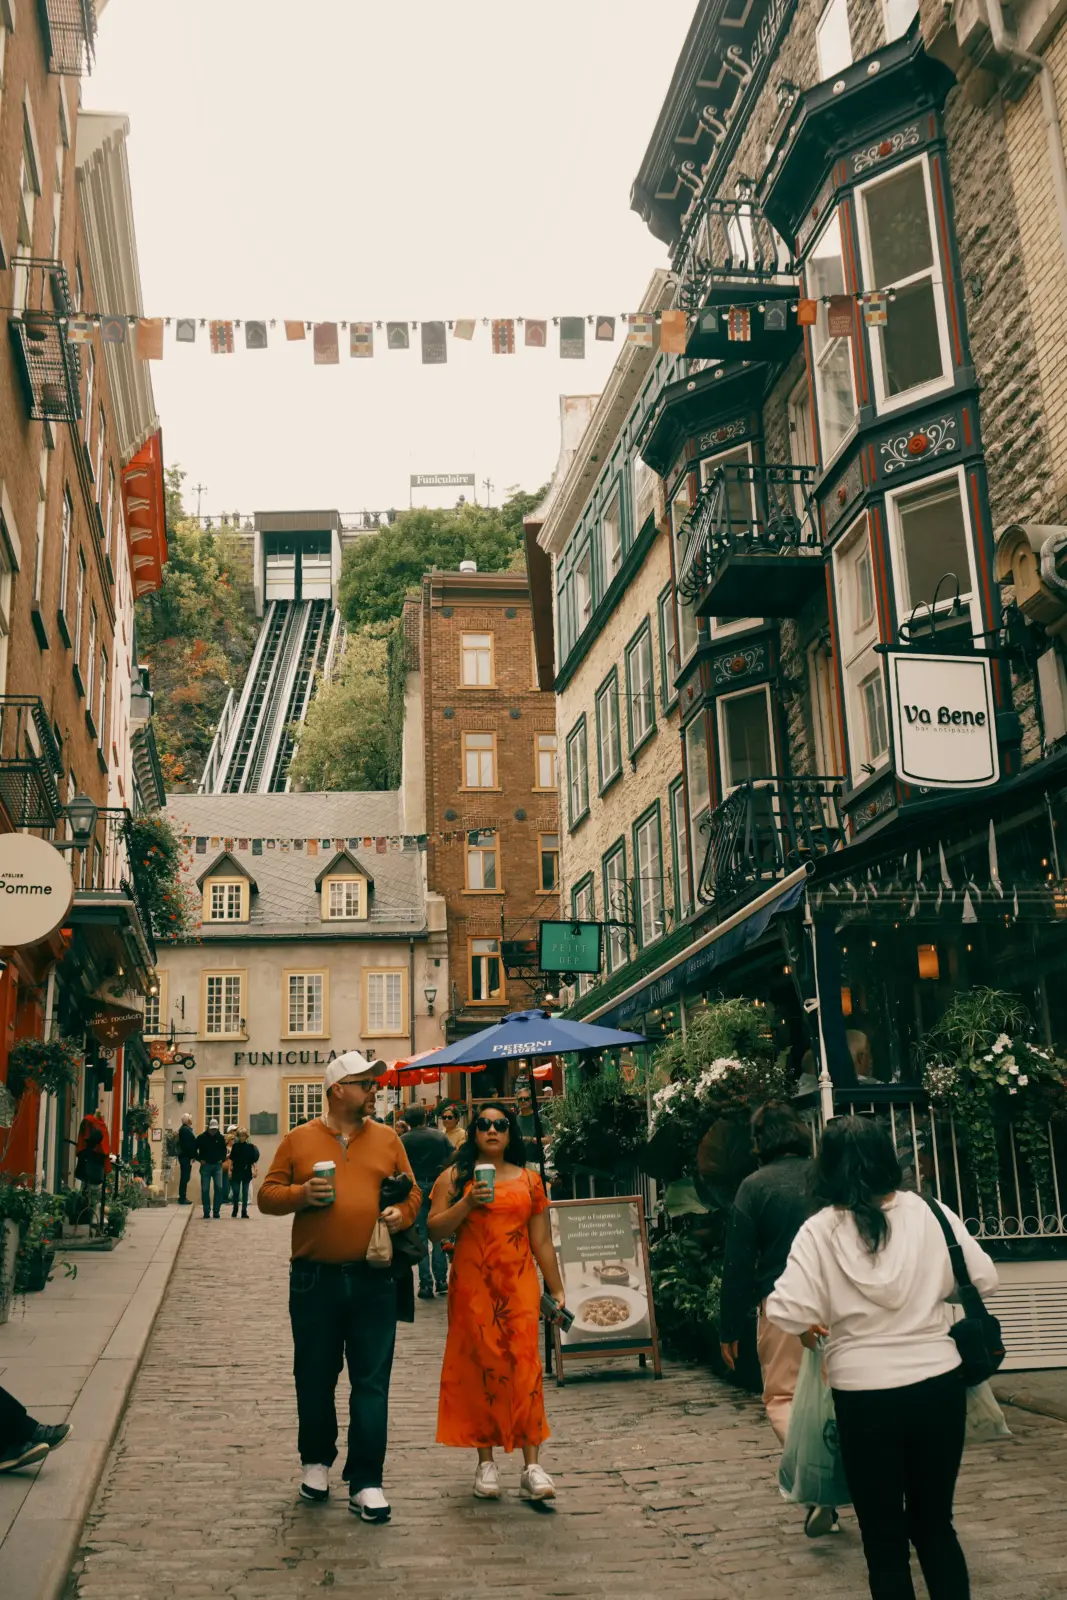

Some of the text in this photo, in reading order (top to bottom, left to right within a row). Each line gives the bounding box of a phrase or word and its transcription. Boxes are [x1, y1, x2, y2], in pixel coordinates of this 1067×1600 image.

[416, 474, 469, 484] Funiculaire
[903, 705, 986, 726] Va Bene
[0, 880, 52, 895] Pomme
[110, 1013, 142, 1023] mouton
[492, 1040, 553, 1052] PERONI
[233, 1049, 377, 1066] FUNICULAE
